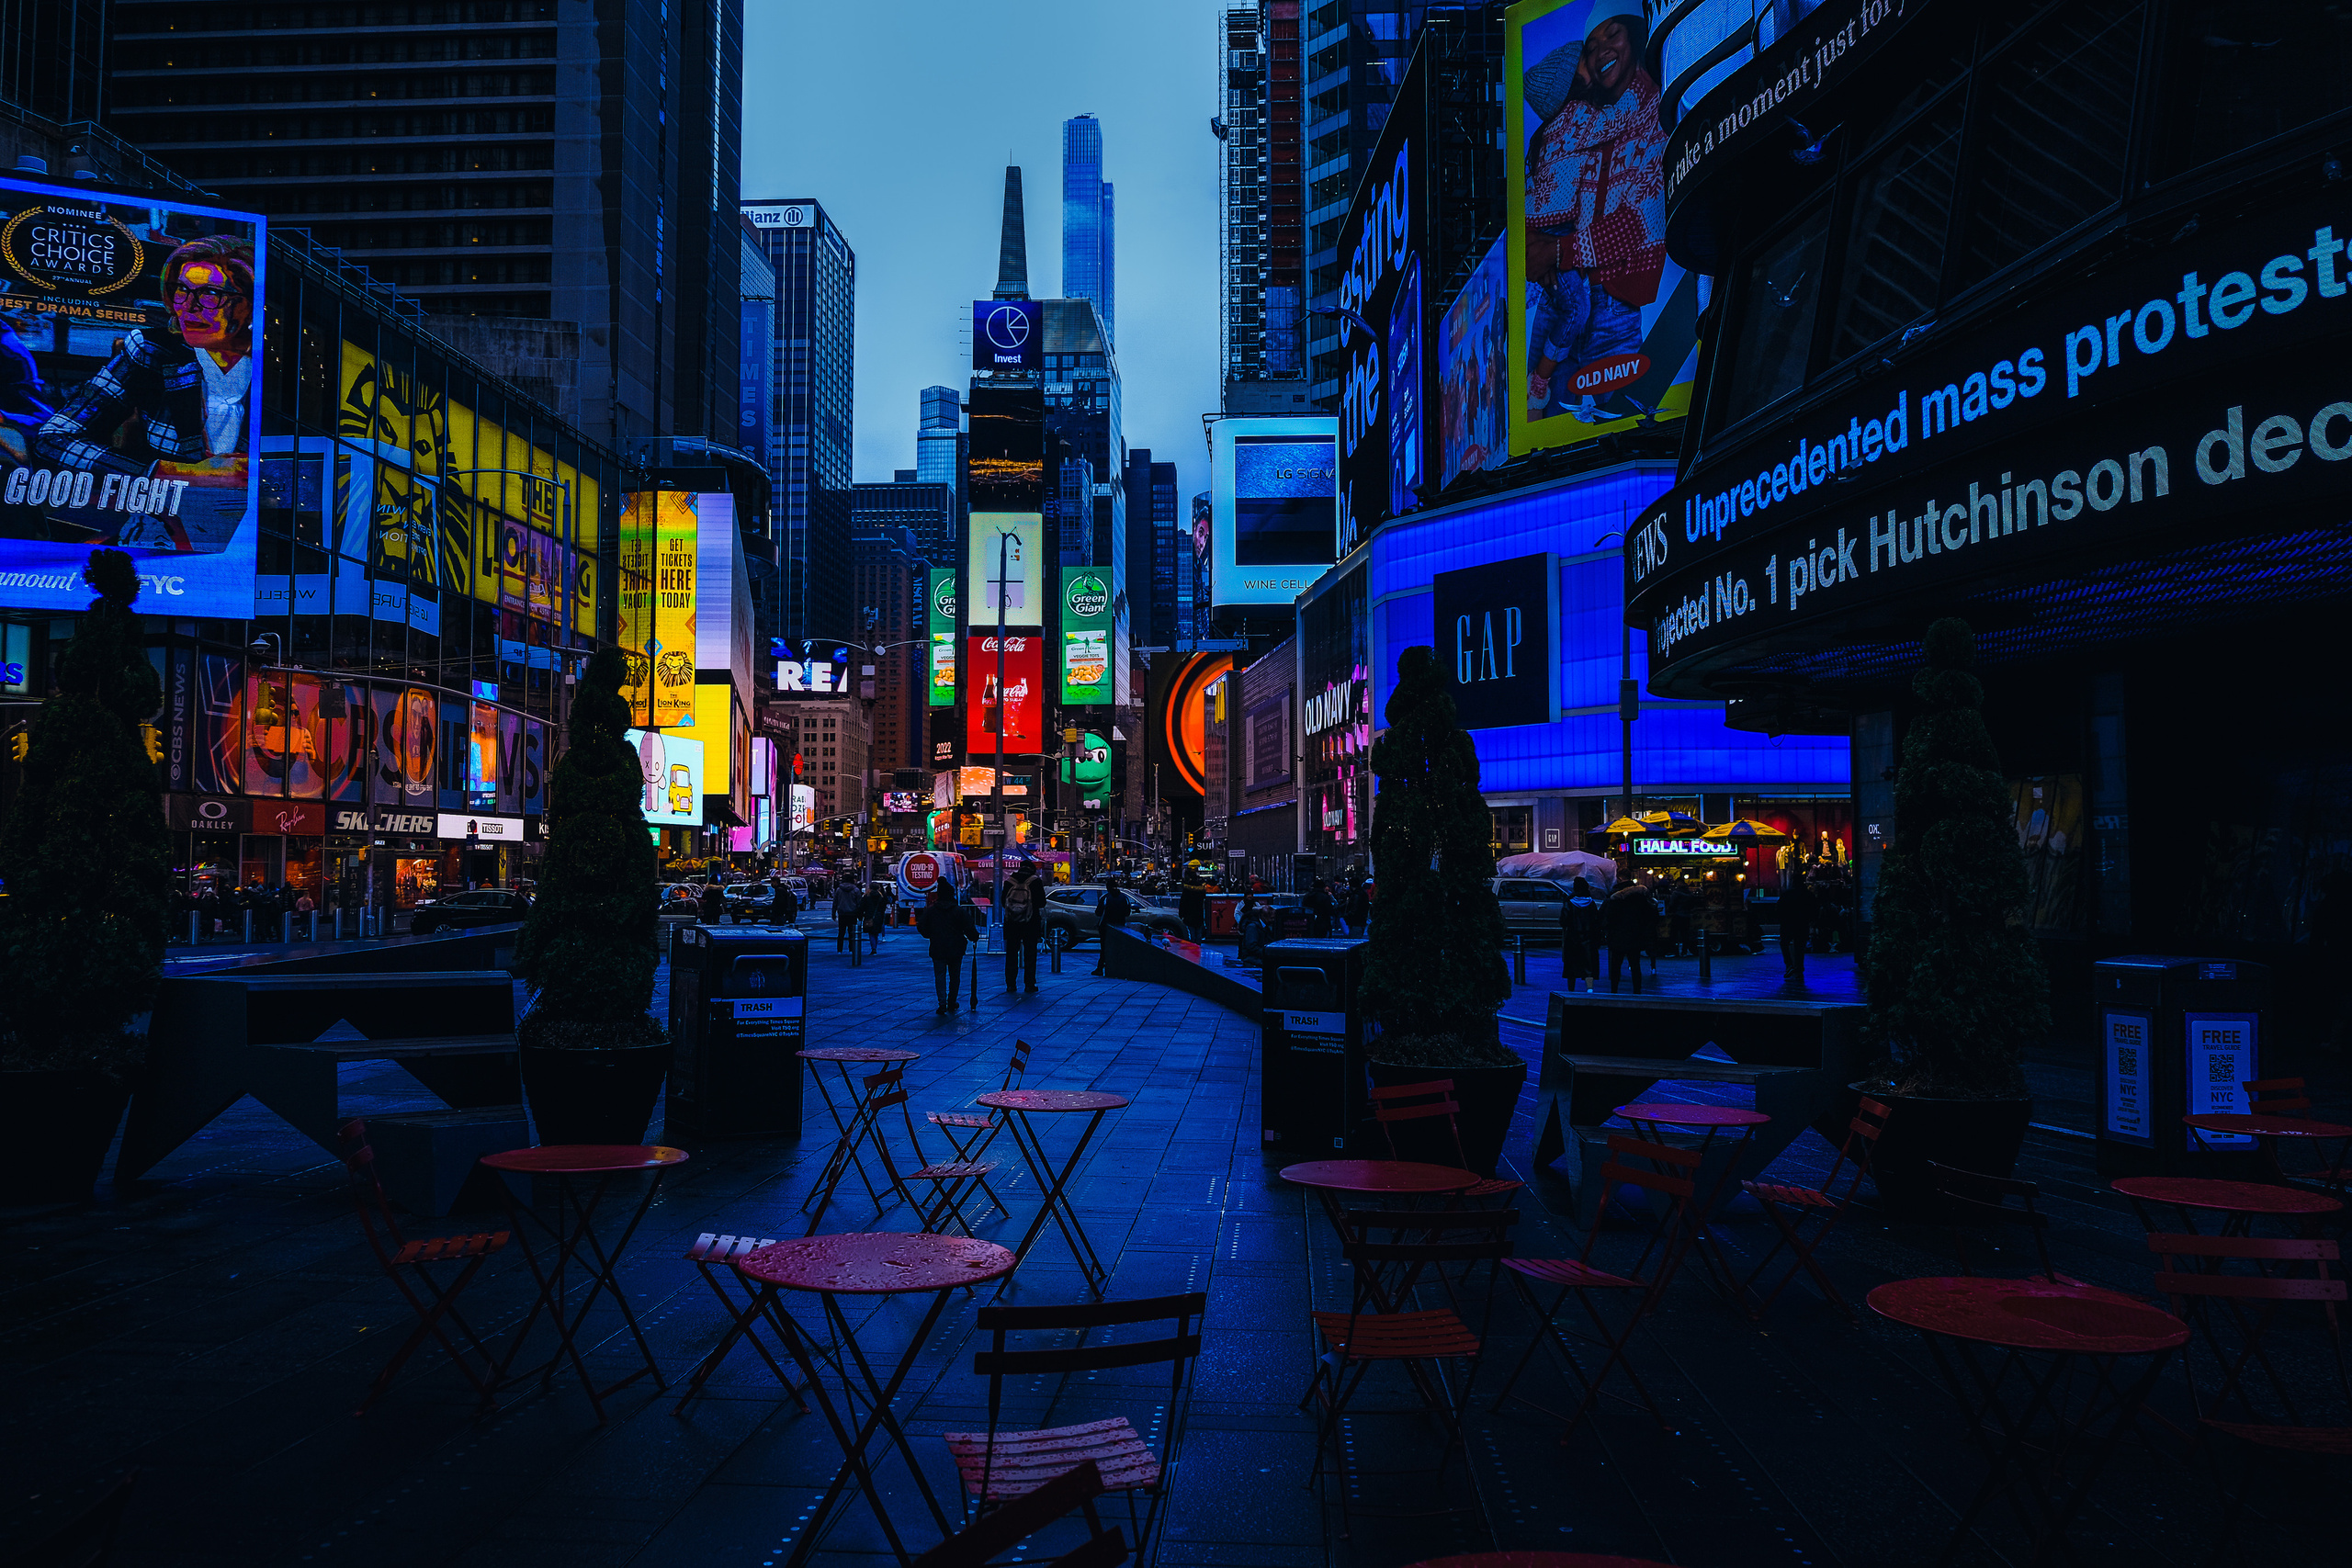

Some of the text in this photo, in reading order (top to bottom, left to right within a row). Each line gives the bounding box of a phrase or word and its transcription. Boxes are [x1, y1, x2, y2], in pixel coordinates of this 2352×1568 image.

[1675, 140, 1702, 186] take
[1704, 131, 1715, 155] a
[1718, 56, 1812, 144] moment
[1814, 18, 1857, 89] just
[47, 205, 102, 220] NOMINEE
[31, 226, 115, 250] CRITICS
[30, 243, 115, 265] CHOICE
[30, 257, 115, 276] AWARDS
[43, 295, 100, 308] INCLUDING
[37, 301, 93, 317] DRAMA
[96, 309, 147, 323] SERIES
[994, 353, 1022, 364] Invest
[741, 317, 760, 427] TIMES
[1577, 359, 1640, 389] OLD NAVY
[1343, 342, 1380, 458] the
[1685, 390, 1908, 544] Unprecedented
[1921, 346, 2047, 441] mass
[1276, 468, 1292, 479] LG
[5, 467, 190, 516] GOOD FIGHT
[1714, 573, 1757, 623] No.
[1765, 553, 1778, 605] 1
[1789, 528, 1859, 610] pick
[1870, 443, 2169, 573] Hutchinson
[670, 538, 684, 551] GET
[662, 554, 692, 567] TICKETS
[662, 569, 691, 590] HERE
[1244, 580, 1277, 590] WINE
[504, 594, 526, 609] ENTRANCE
[662, 592, 691, 608] TODAY
[1071, 593, 1104, 604] Green
[1076, 604, 1106, 613] Giant
[1456, 606, 1522, 685] GAP
[658, 699, 691, 708] LION KING
[1305, 681, 1351, 737] OLD NAVY
[171, 662, 186, 764] CBS NEWS
[936, 741, 952, 754] 2022
[1013, 776, 1023, 785] 44
[191, 818, 234, 830] OAKLEY
[276, 805, 306, 832] Ray-Ban
[482, 822, 503, 834] TISSOT
[1548, 833, 1557, 843] GAP
[1640, 840, 1732, 853] HALAL FOOD
[910, 863, 934, 872] COVID-19
[911, 871, 933, 879] TESTING
[741, 1003, 773, 1011] TRASH
[1290, 1016, 1318, 1025] TRASH
[2113, 1023, 2142, 1039] FREE
[2202, 1030, 2241, 1043] FREE
[2120, 1084, 2137, 1096] NYC
[2211, 1091, 2233, 1102] NYC
